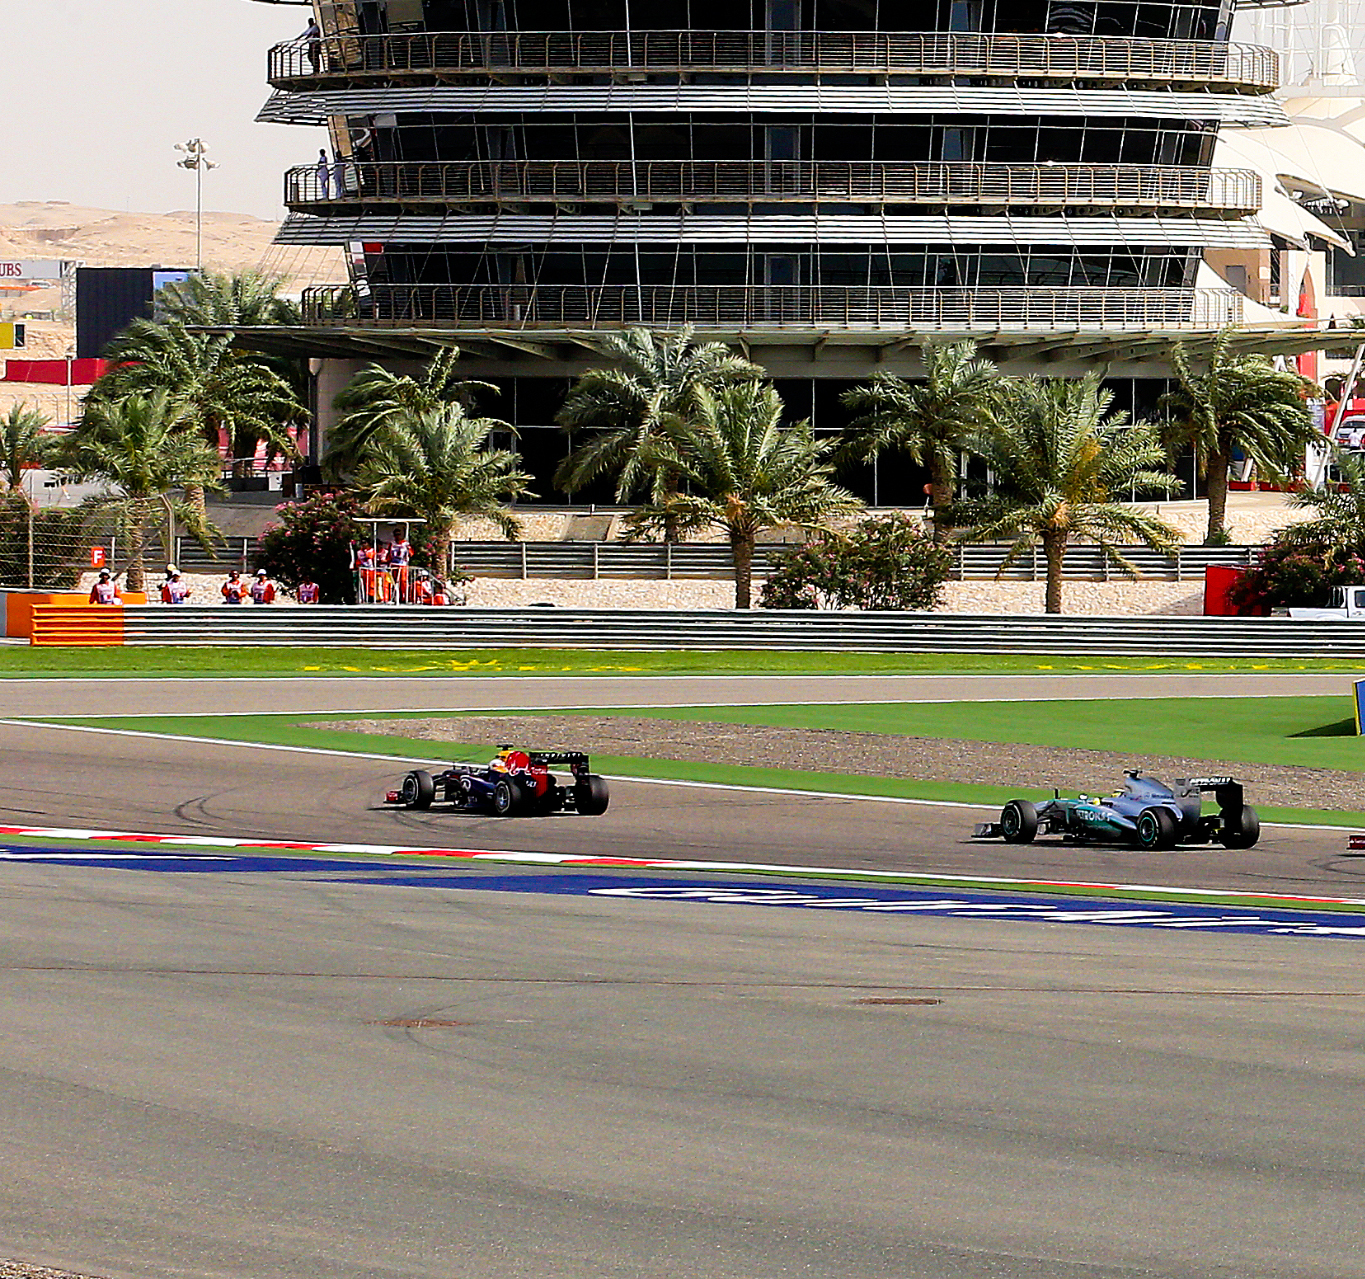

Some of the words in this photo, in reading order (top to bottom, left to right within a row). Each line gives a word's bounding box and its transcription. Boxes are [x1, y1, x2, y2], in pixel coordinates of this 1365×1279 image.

[94, 550, 103, 563] F
[587, 886, 1057, 911] Gulf
[949, 910, 1318, 928] Air
